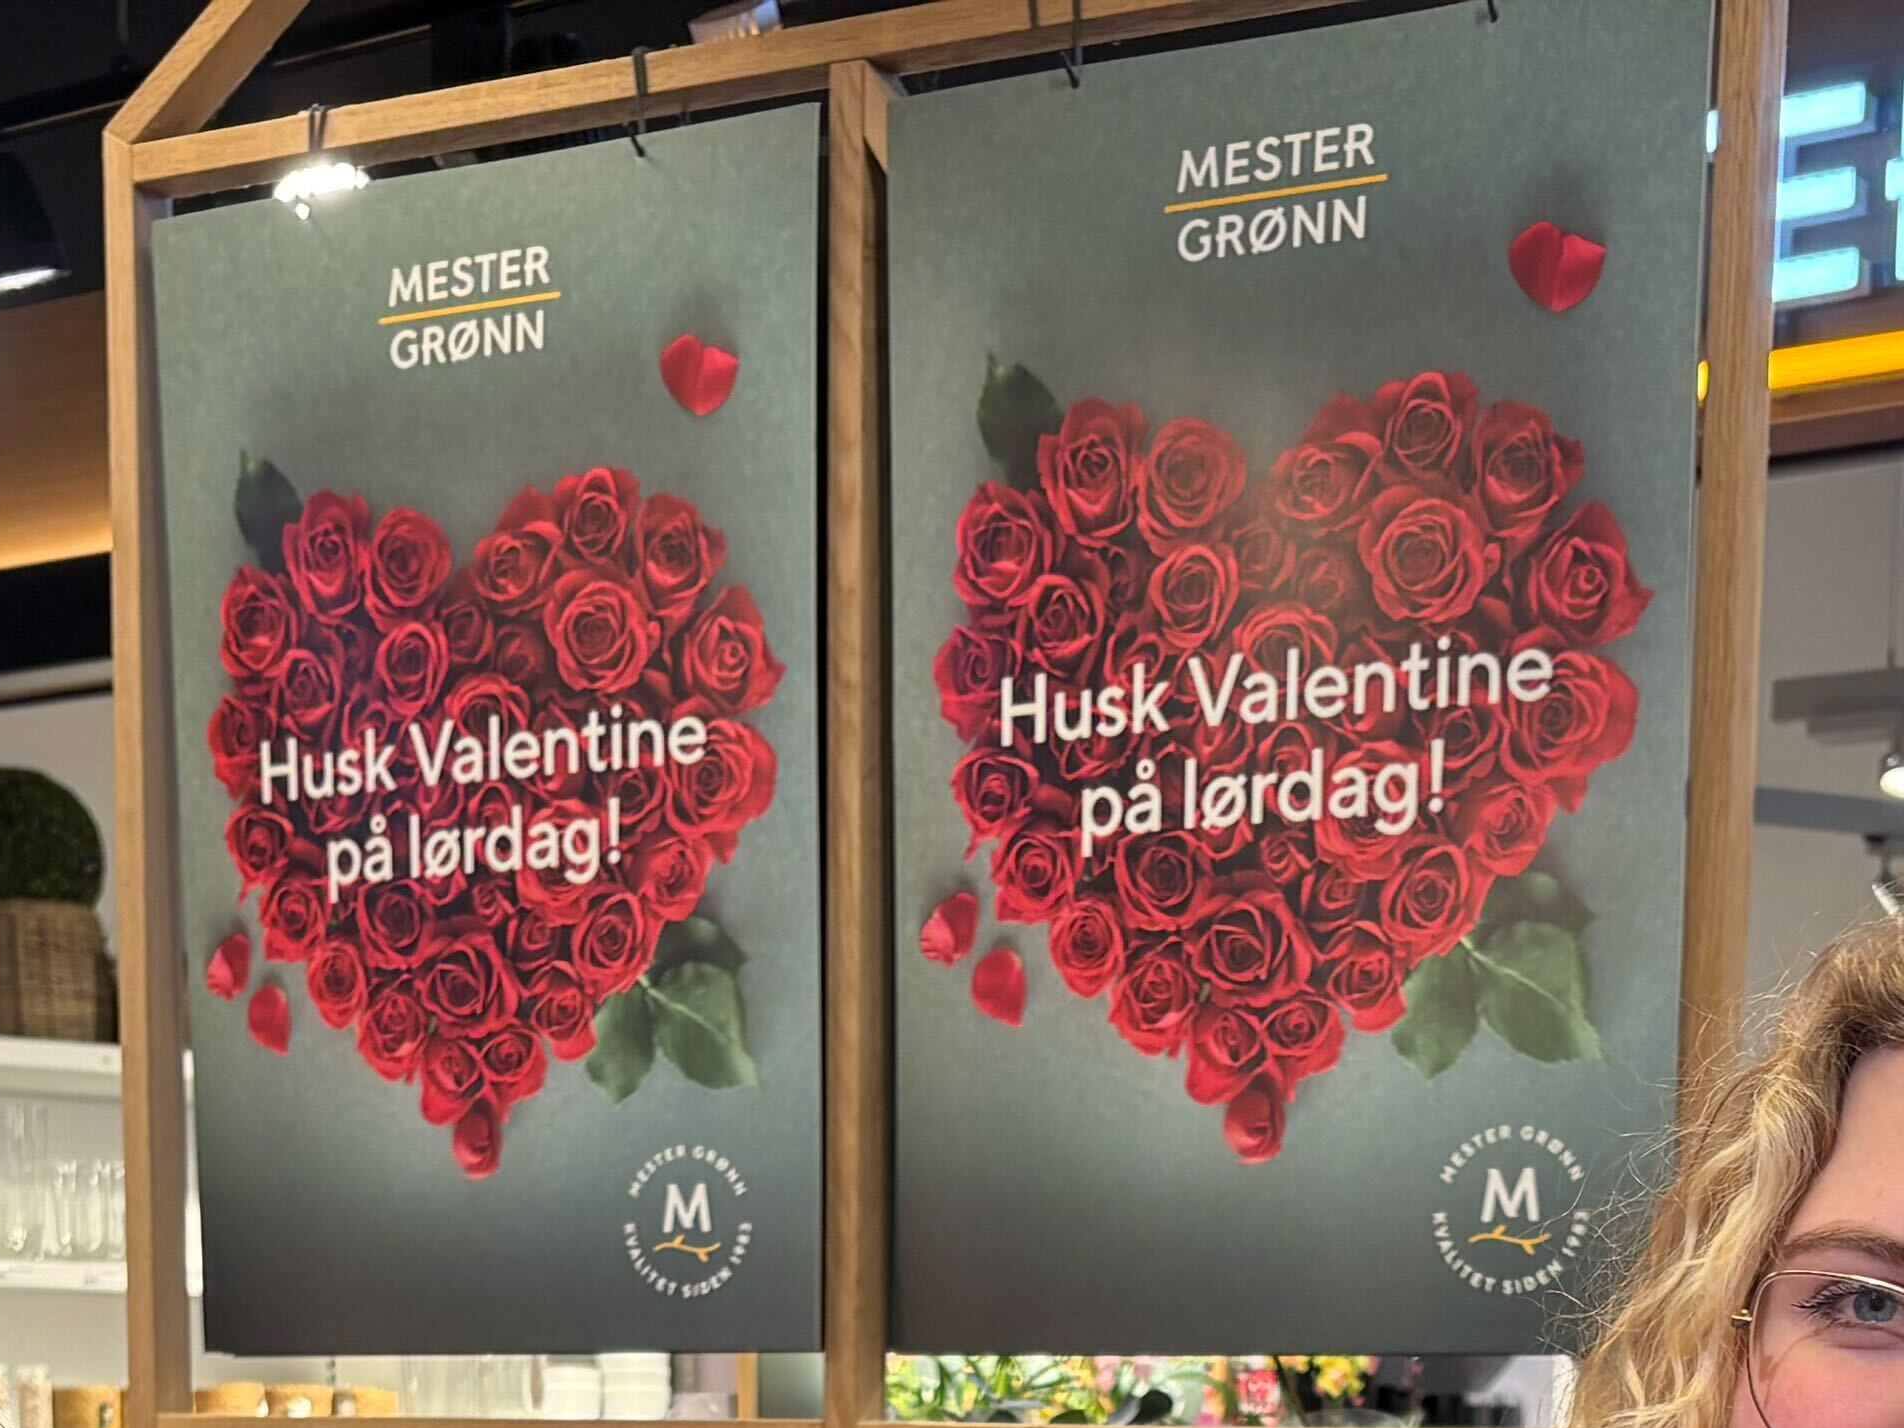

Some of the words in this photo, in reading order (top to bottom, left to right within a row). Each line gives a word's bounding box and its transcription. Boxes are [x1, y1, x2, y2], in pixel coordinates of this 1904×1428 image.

[1177, 122, 1375, 194] MESTER
[1177, 195, 1367, 262] GRØNN
[388, 246, 550, 308] MESTER
[389, 310, 546, 369] GRØNN
[1000, 664, 1169, 747] Husk
[1188, 636, 1553, 727] Valentine
[260, 728, 397, 805] Husk
[409, 704, 707, 786] Valentine
[1080, 759, 1163, 858] på
[1184, 738, 1445, 836] lørdag!
[327, 814, 393, 904] på
[409, 797, 622, 884] lørdag!
[628, 1144, 686, 1198] MESTER
[1440, 1125, 1512, 1184] MESTER
[1519, 1125, 1585, 1182] GRØNN
[662, 1183, 712, 1233] M
[1480, 1167, 1540, 1223] M
